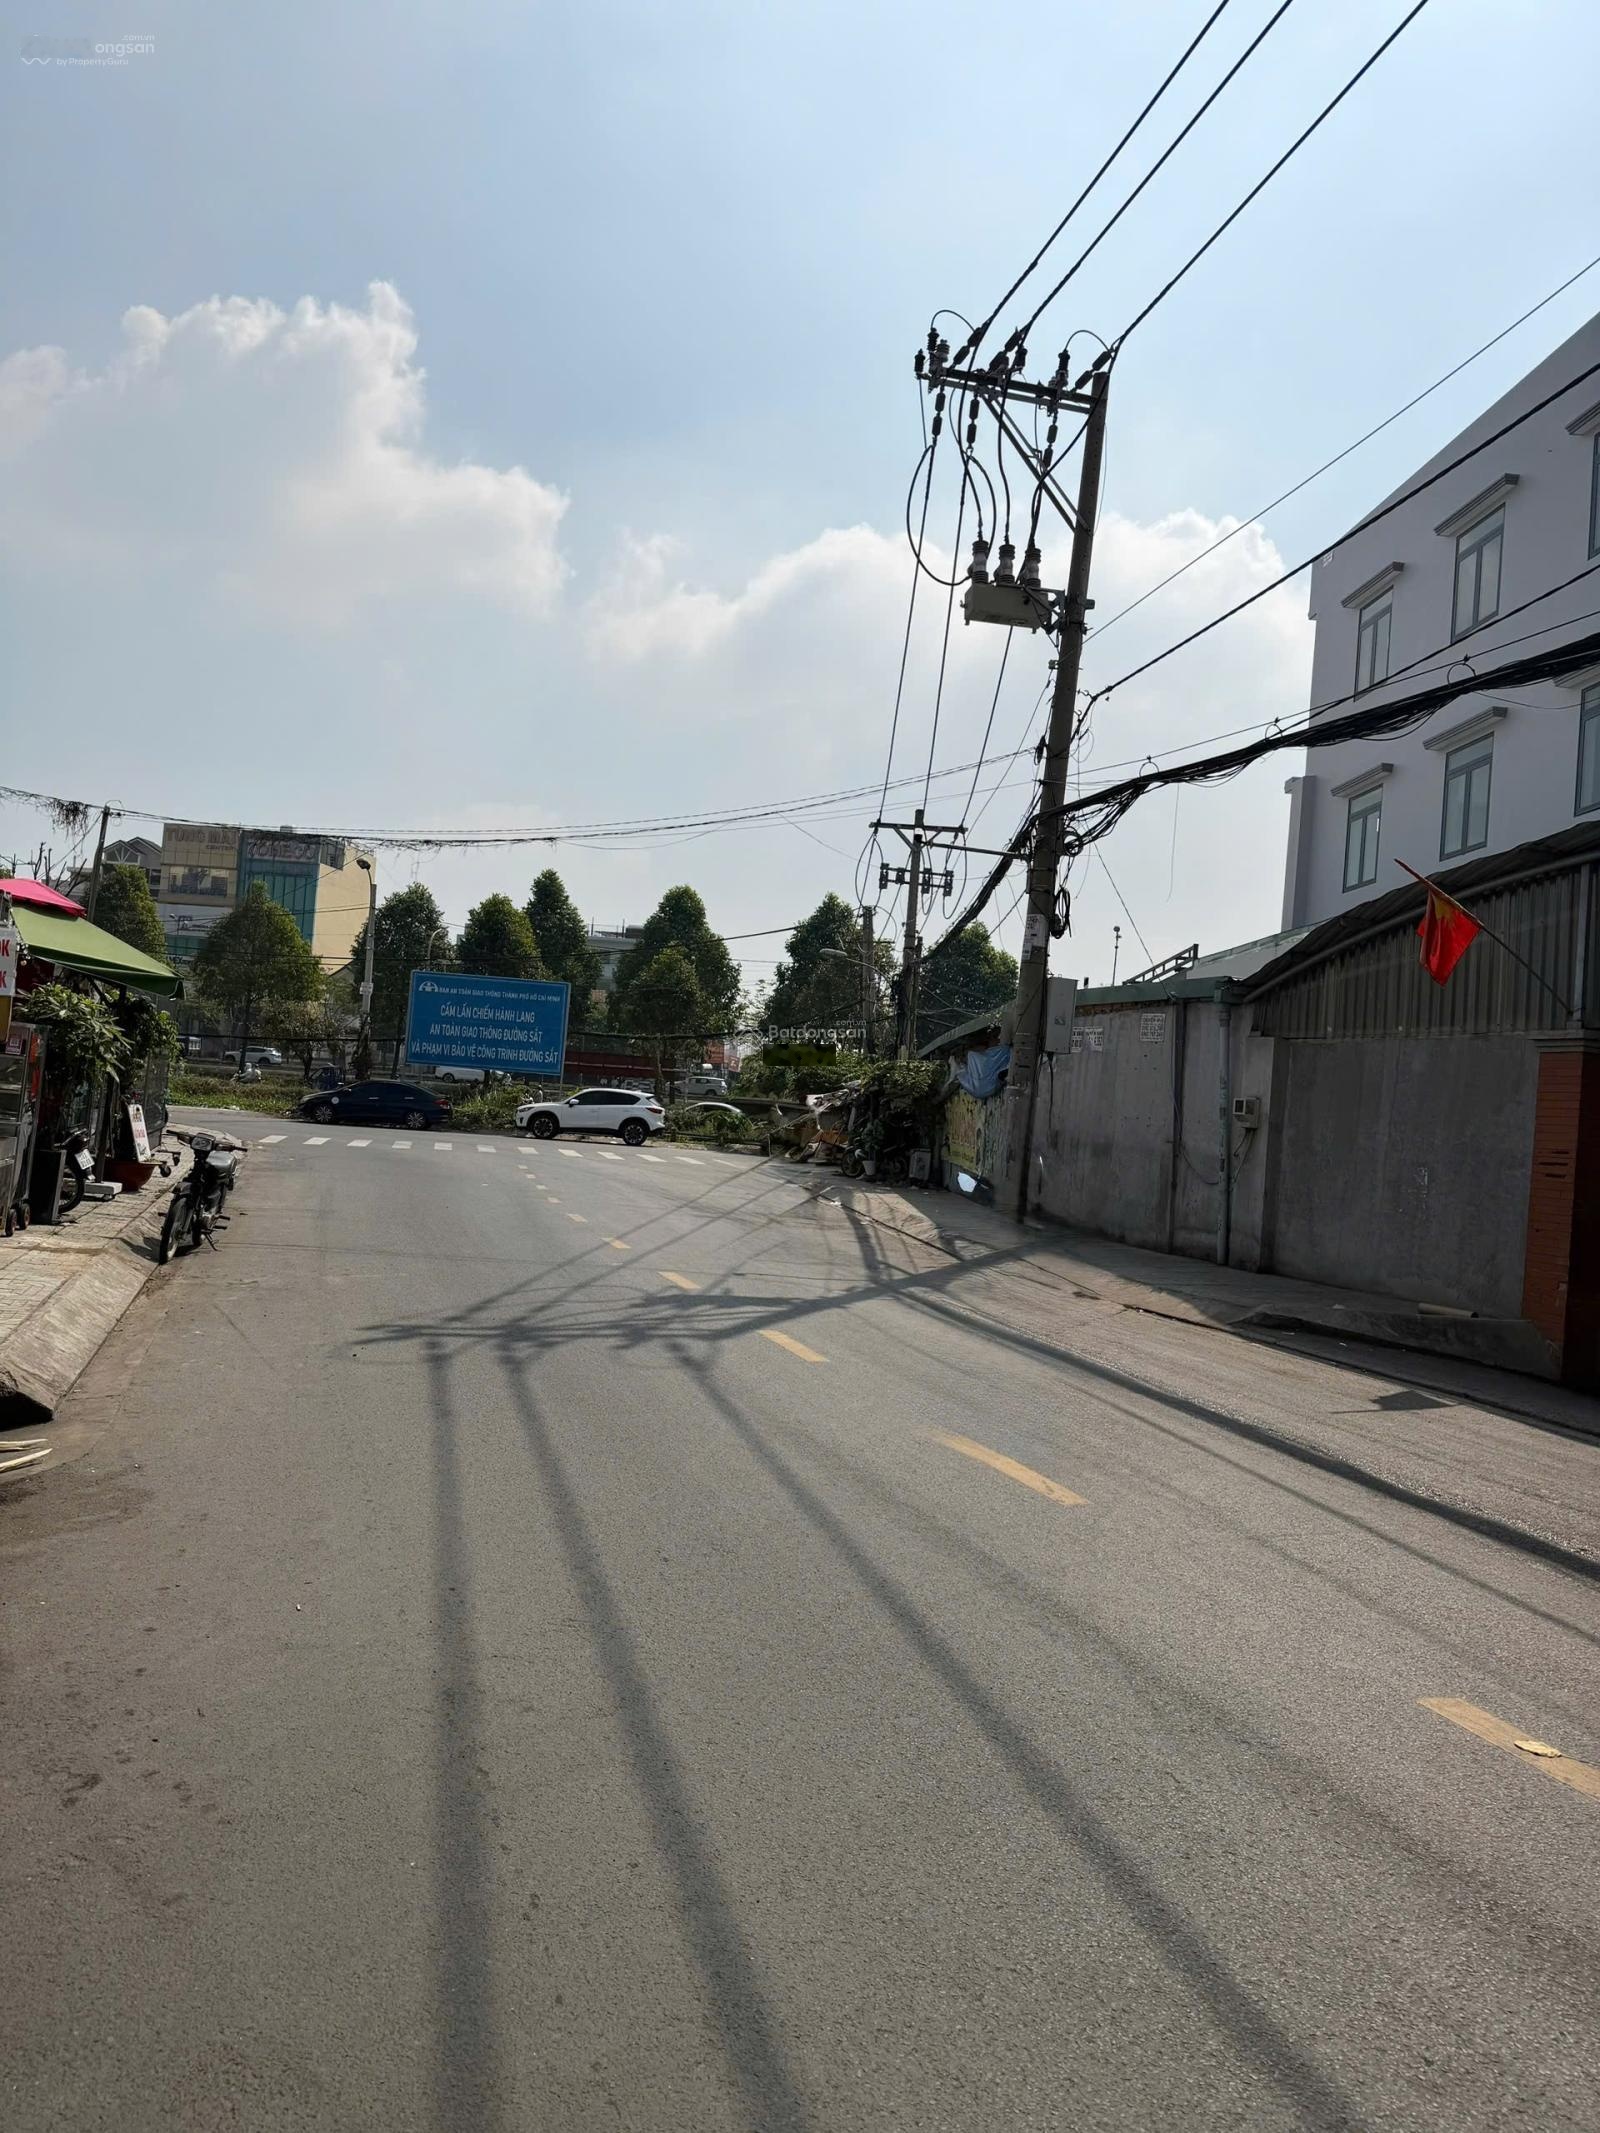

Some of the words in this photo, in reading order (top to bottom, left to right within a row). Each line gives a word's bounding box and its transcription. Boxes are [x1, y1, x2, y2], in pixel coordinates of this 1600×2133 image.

[440, 1001, 455, 1017] CẤM
[456, 1001, 471, 1018] LẤN
[472, 1003, 494, 1020] CHIẾM
[495, 1006, 515, 1022] HÀNH
[516, 1010, 535, 1023] LANG
[430, 1023, 441, 1035] AN
[442, 1021, 461, 1037] TOÀN
[461, 1026, 478, 1038] GIAO
[479, 1025, 502, 1040] THÔNG
[503, 1026, 528, 1042] ĐƯỜNG
[529, 1027, 543, 1043] SẮT
[411, 1041, 421, 1054] VÀ
[421, 1043, 442, 1057] PHẠM
[443, 1044, 451, 1055] VI
[451, 1041, 465, 1057] BẢO
[466, 1045, 477, 1061] VỆ
[477, 1043, 496, 1059] CÔNG
[497, 1045, 518, 1061] TRÌNH
[544, 1047, 558, 1064] SẮT
